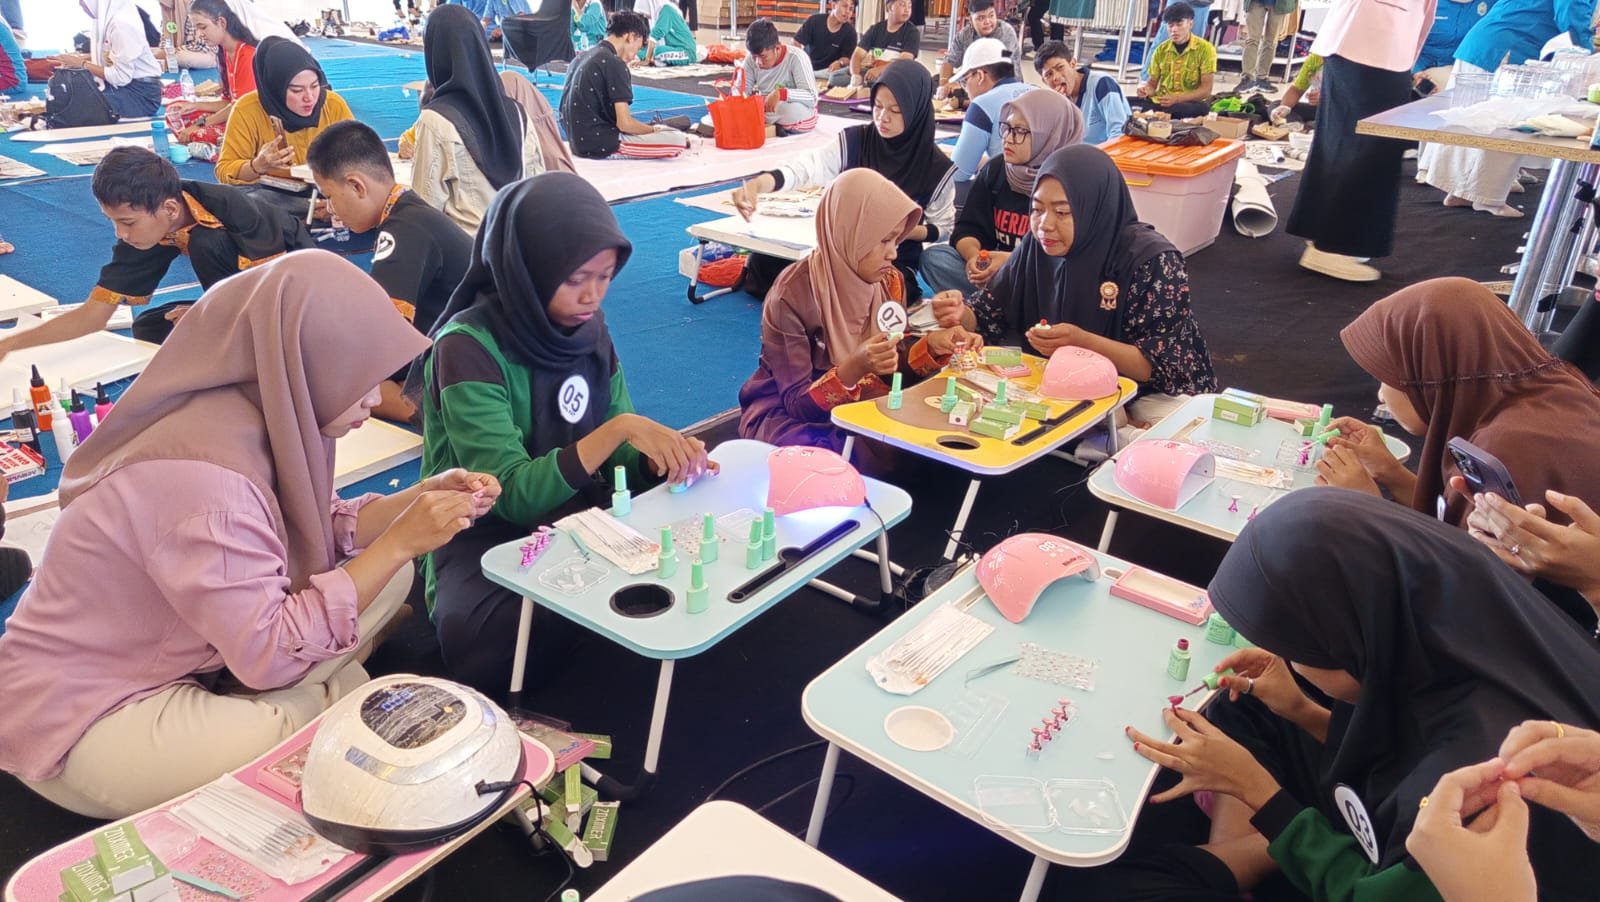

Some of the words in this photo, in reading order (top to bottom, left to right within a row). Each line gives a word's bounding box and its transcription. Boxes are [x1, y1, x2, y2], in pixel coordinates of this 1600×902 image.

[882, 306, 903, 329] 07
[563, 384, 584, 412] 05
[1344, 799, 1374, 849] 03
